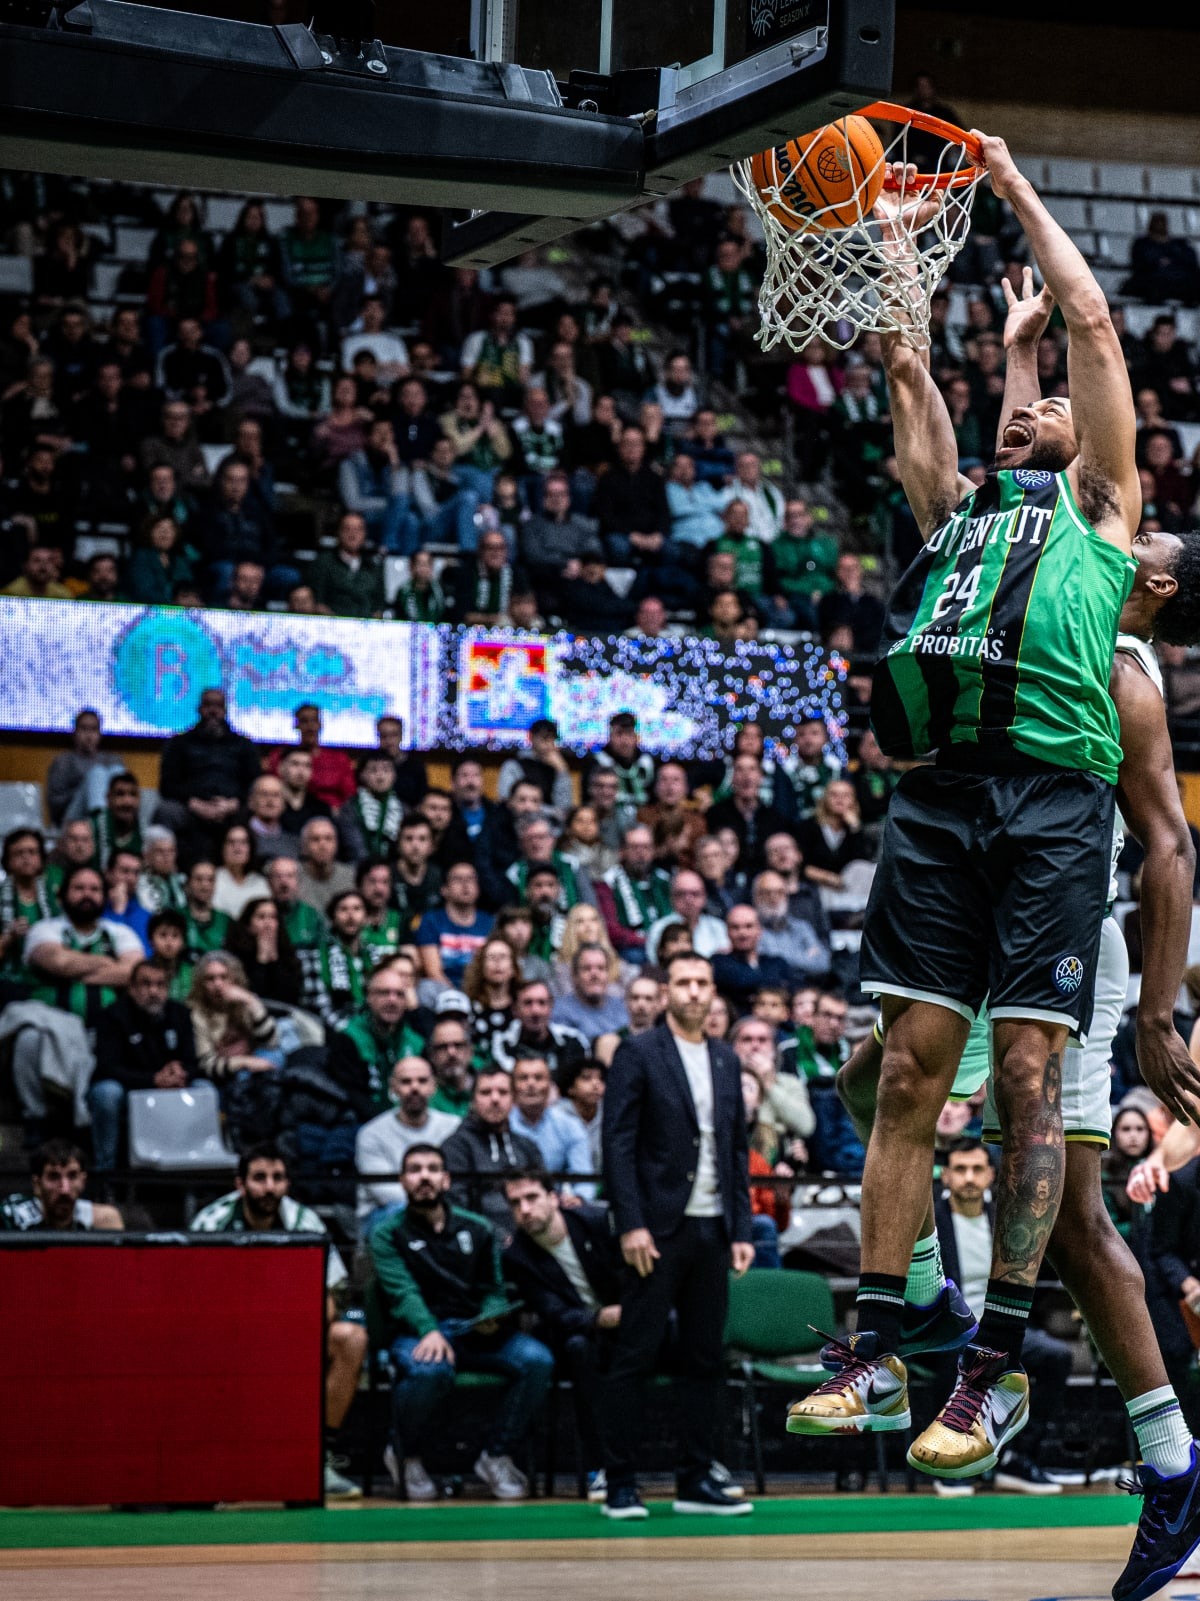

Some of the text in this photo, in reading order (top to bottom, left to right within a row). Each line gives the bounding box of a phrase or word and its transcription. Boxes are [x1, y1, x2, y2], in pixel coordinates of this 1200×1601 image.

[919, 505, 1053, 558] OVENTUT
[932, 565, 984, 619] 24
[909, 634, 1004, 661] PROBITAS
[919, 625, 1007, 638] UNDACIÓN
